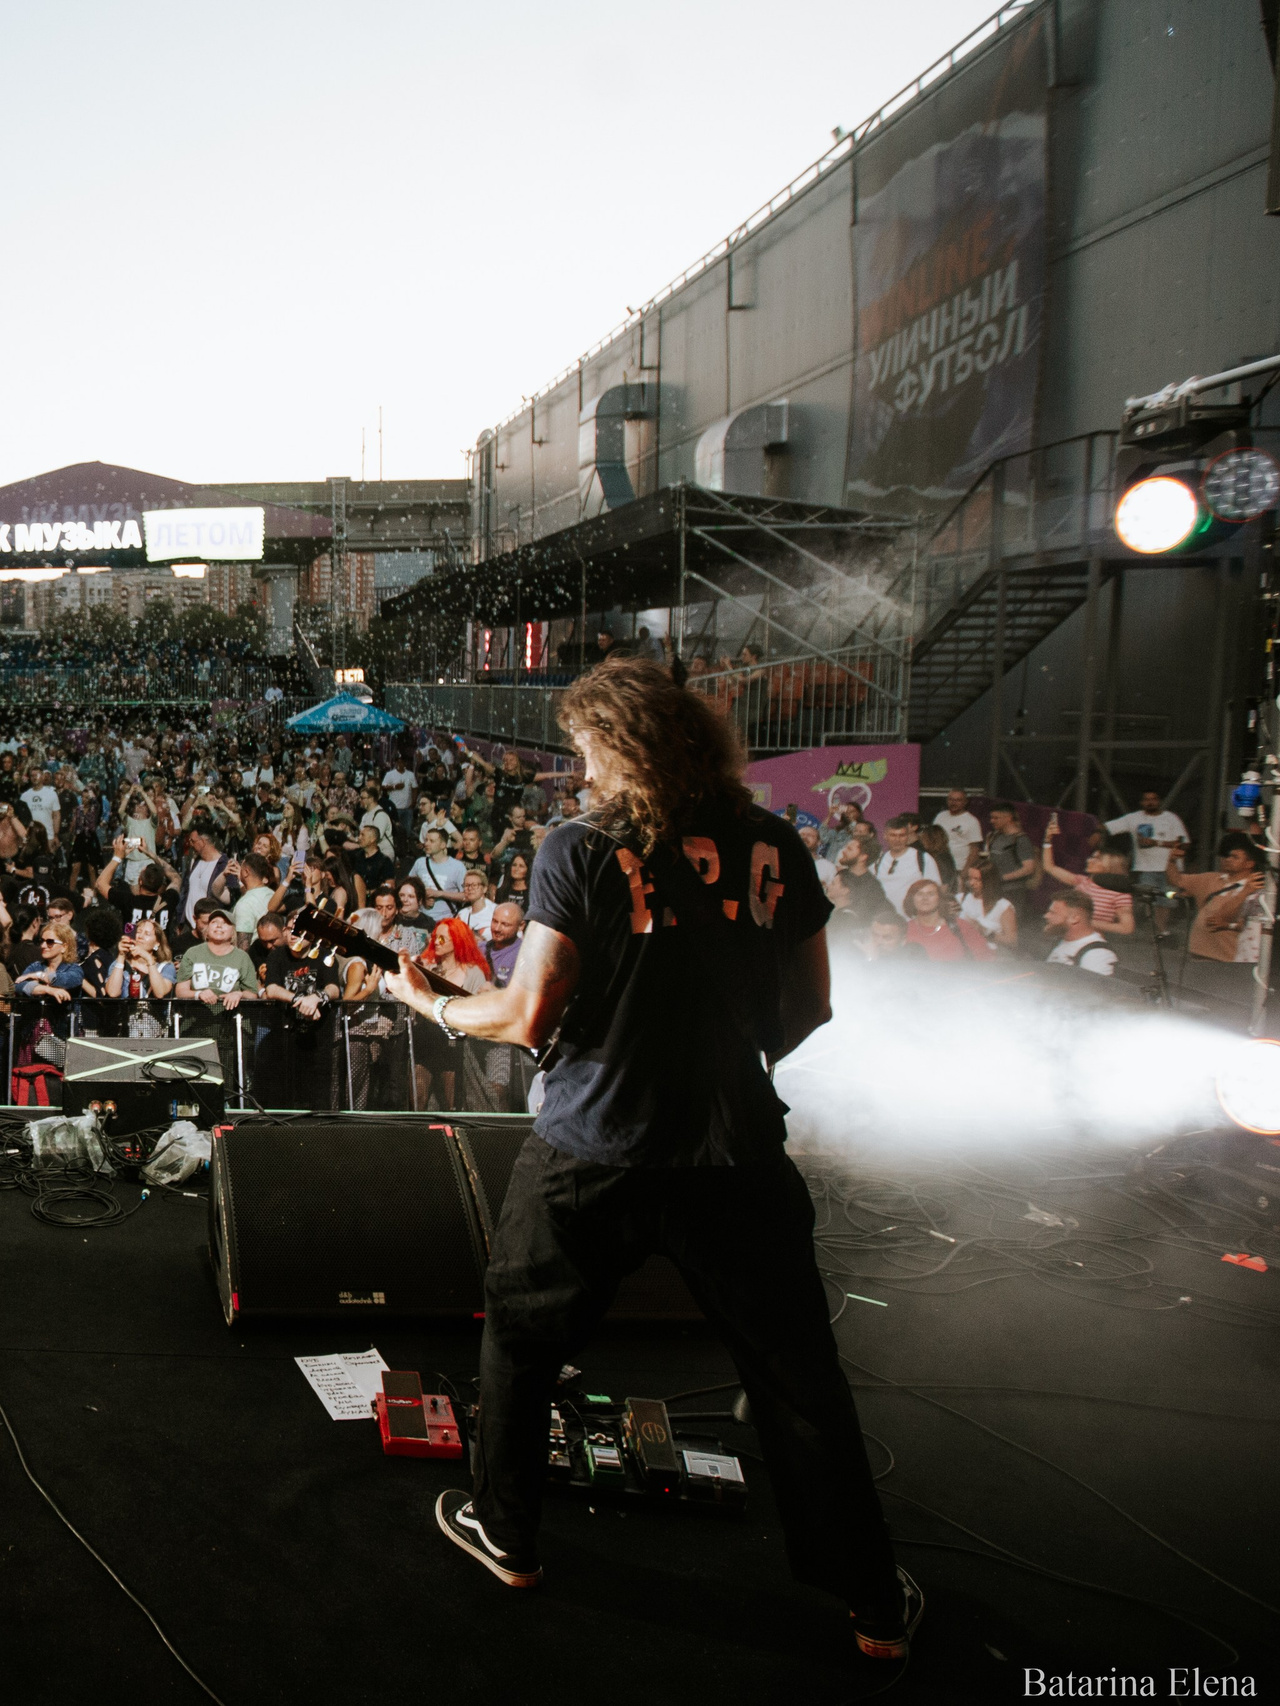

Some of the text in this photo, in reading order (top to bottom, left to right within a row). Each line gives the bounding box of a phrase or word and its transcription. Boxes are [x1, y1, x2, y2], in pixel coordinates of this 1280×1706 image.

[894, 303, 1029, 415] ФУТБОЛ
[14, 519, 143, 552] МУЗЫКА
[154, 521, 254, 547] ЛЕТОМ
